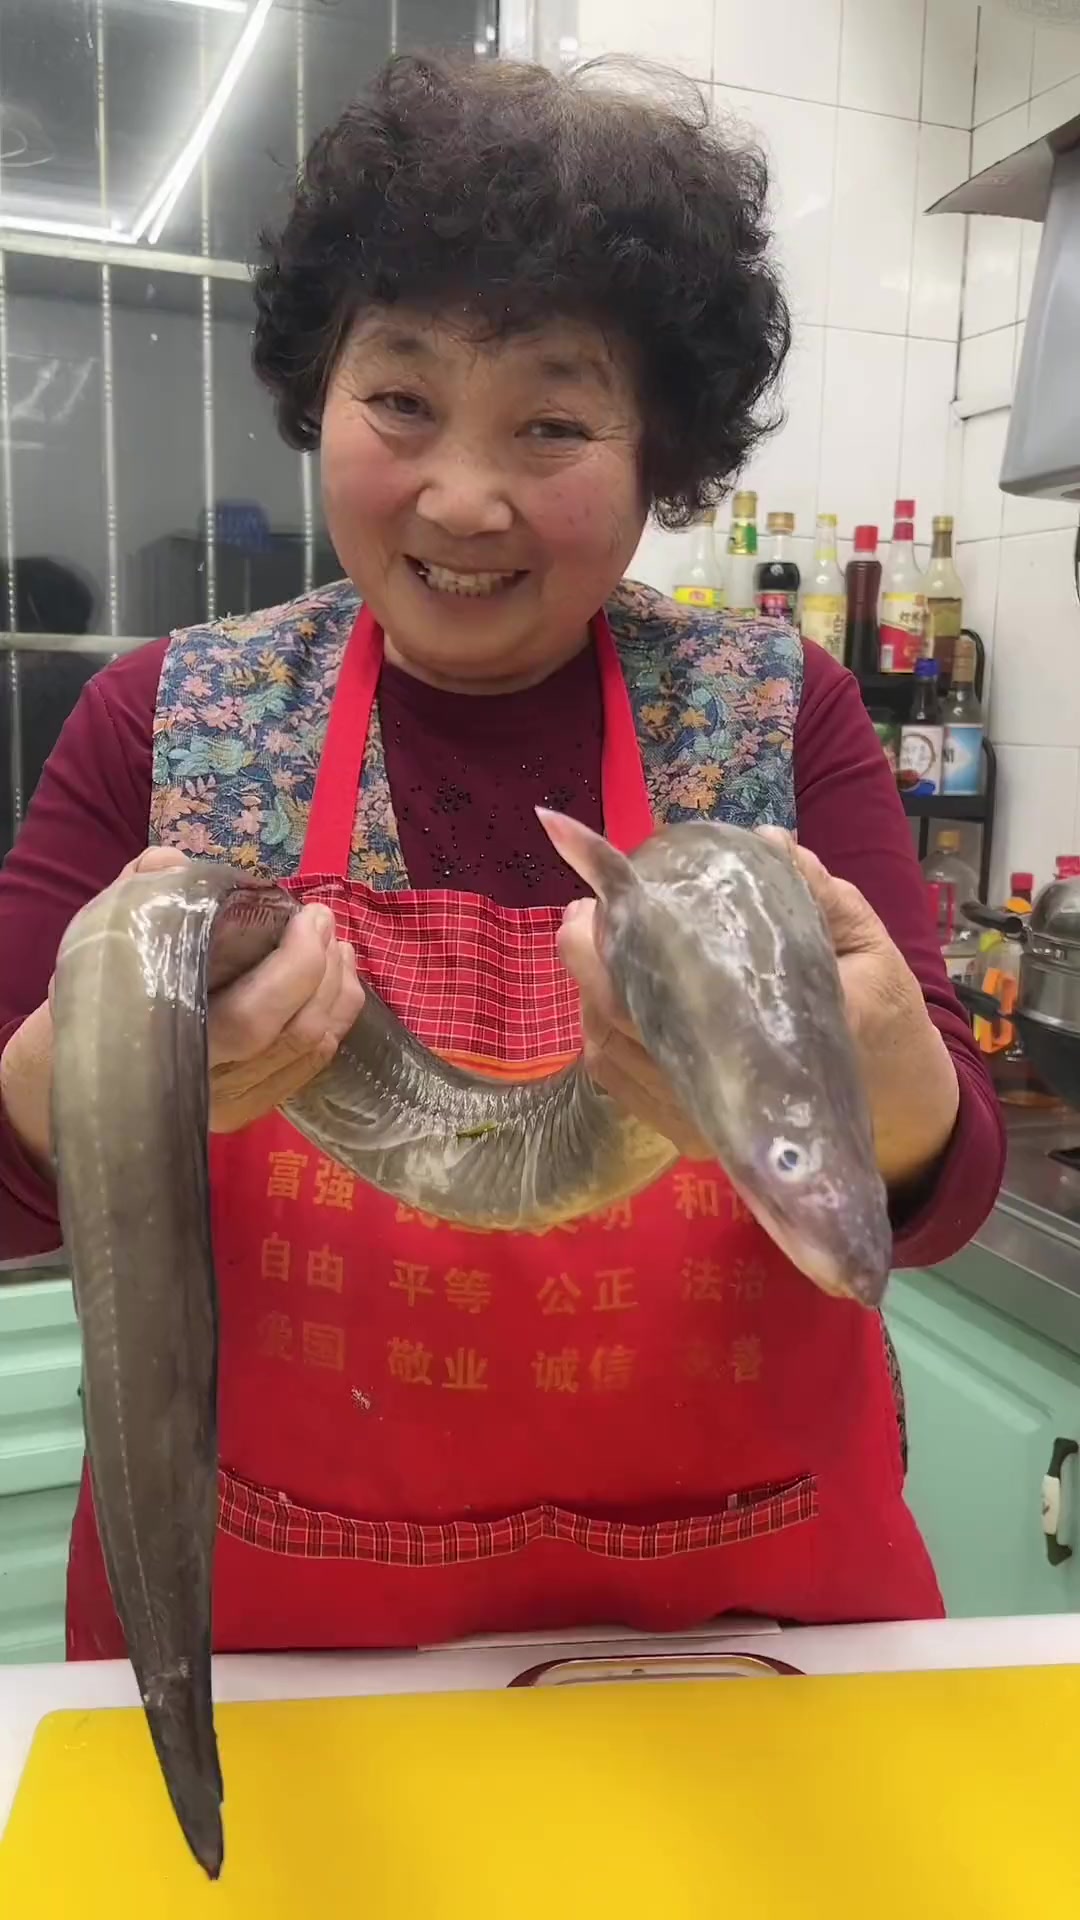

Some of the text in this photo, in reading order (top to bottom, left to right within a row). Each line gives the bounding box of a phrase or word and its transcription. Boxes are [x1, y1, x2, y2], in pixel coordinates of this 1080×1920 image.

[266, 1149, 354, 1211] 富强
[260, 1231, 767, 1316] 自由 平等 公正 法治
[387, 1336, 489, 1391] 敬业
[531, 1343, 638, 1394] 诚信
